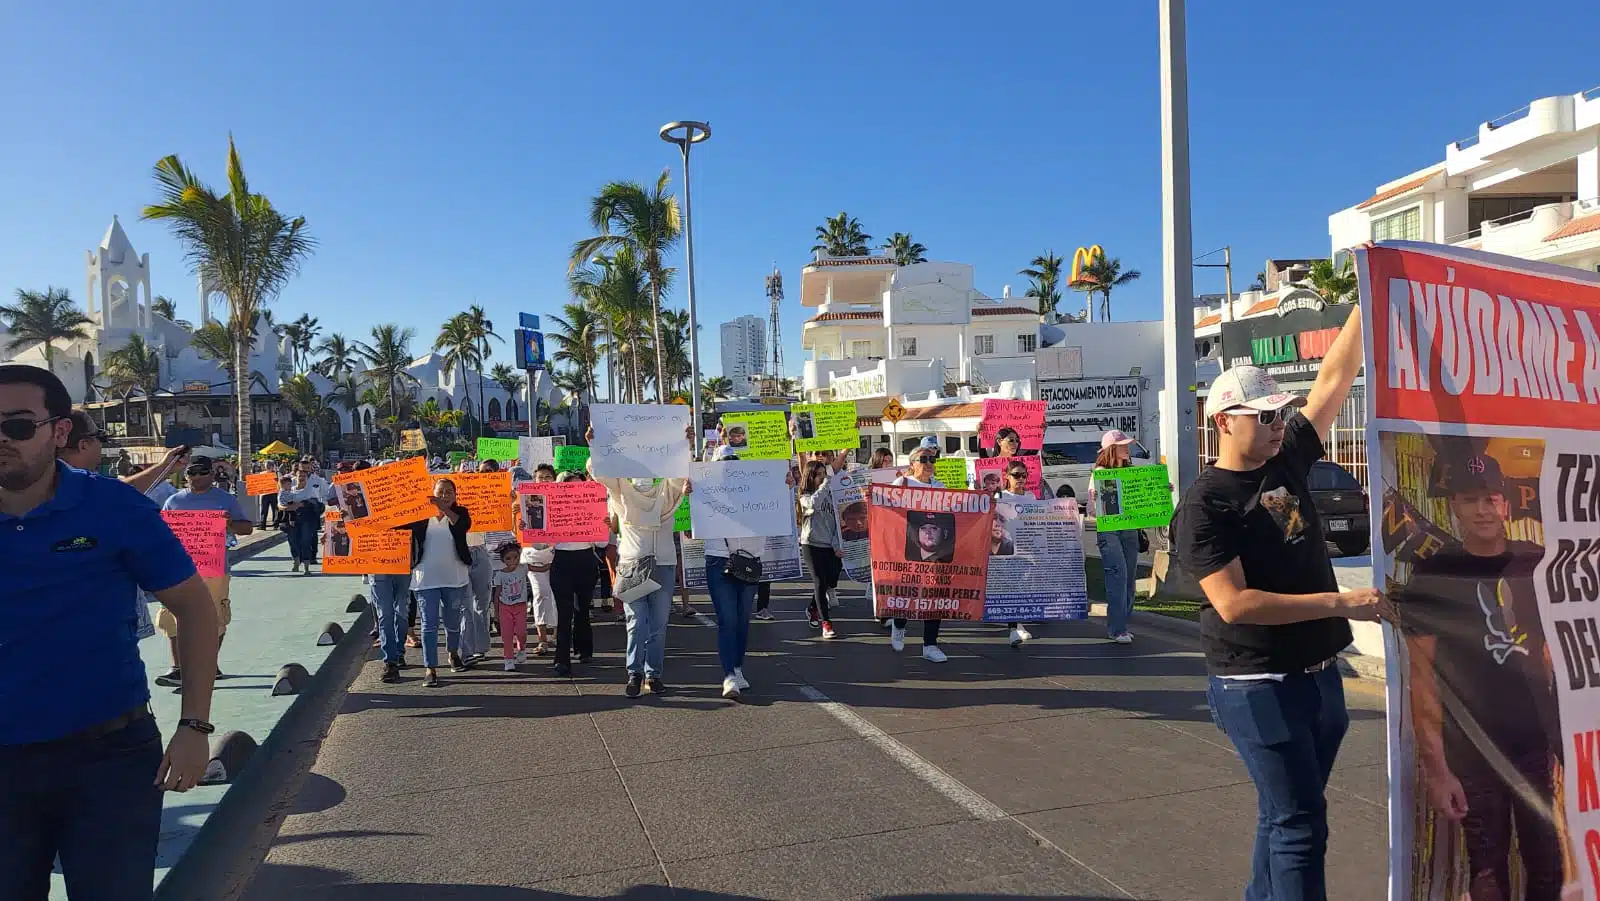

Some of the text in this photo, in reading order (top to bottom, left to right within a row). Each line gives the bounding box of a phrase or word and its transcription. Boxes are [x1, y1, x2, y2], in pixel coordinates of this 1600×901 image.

[1298, 297, 1321, 312] ESTILO
[1388, 266, 1579, 403] AYÚDAME
[1251, 334, 1298, 365] VILLA
[1267, 364, 1308, 376] QUESADILLAS
[1040, 382, 1138, 402] ESTACIONAMIENTO PÚBLICO
[1116, 416, 1137, 431] LIBRE
[872, 485, 991, 514] DESAPARECIDO
[879, 562, 913, 573] OCTUBRE
[914, 563, 935, 576] 2024
[925, 575, 936, 586] 33
[894, 585, 919, 598] LUIS
[921, 586, 951, 599] OSUNA
[952, 588, 981, 601] PEREZ
[887, 597, 911, 609] 667
